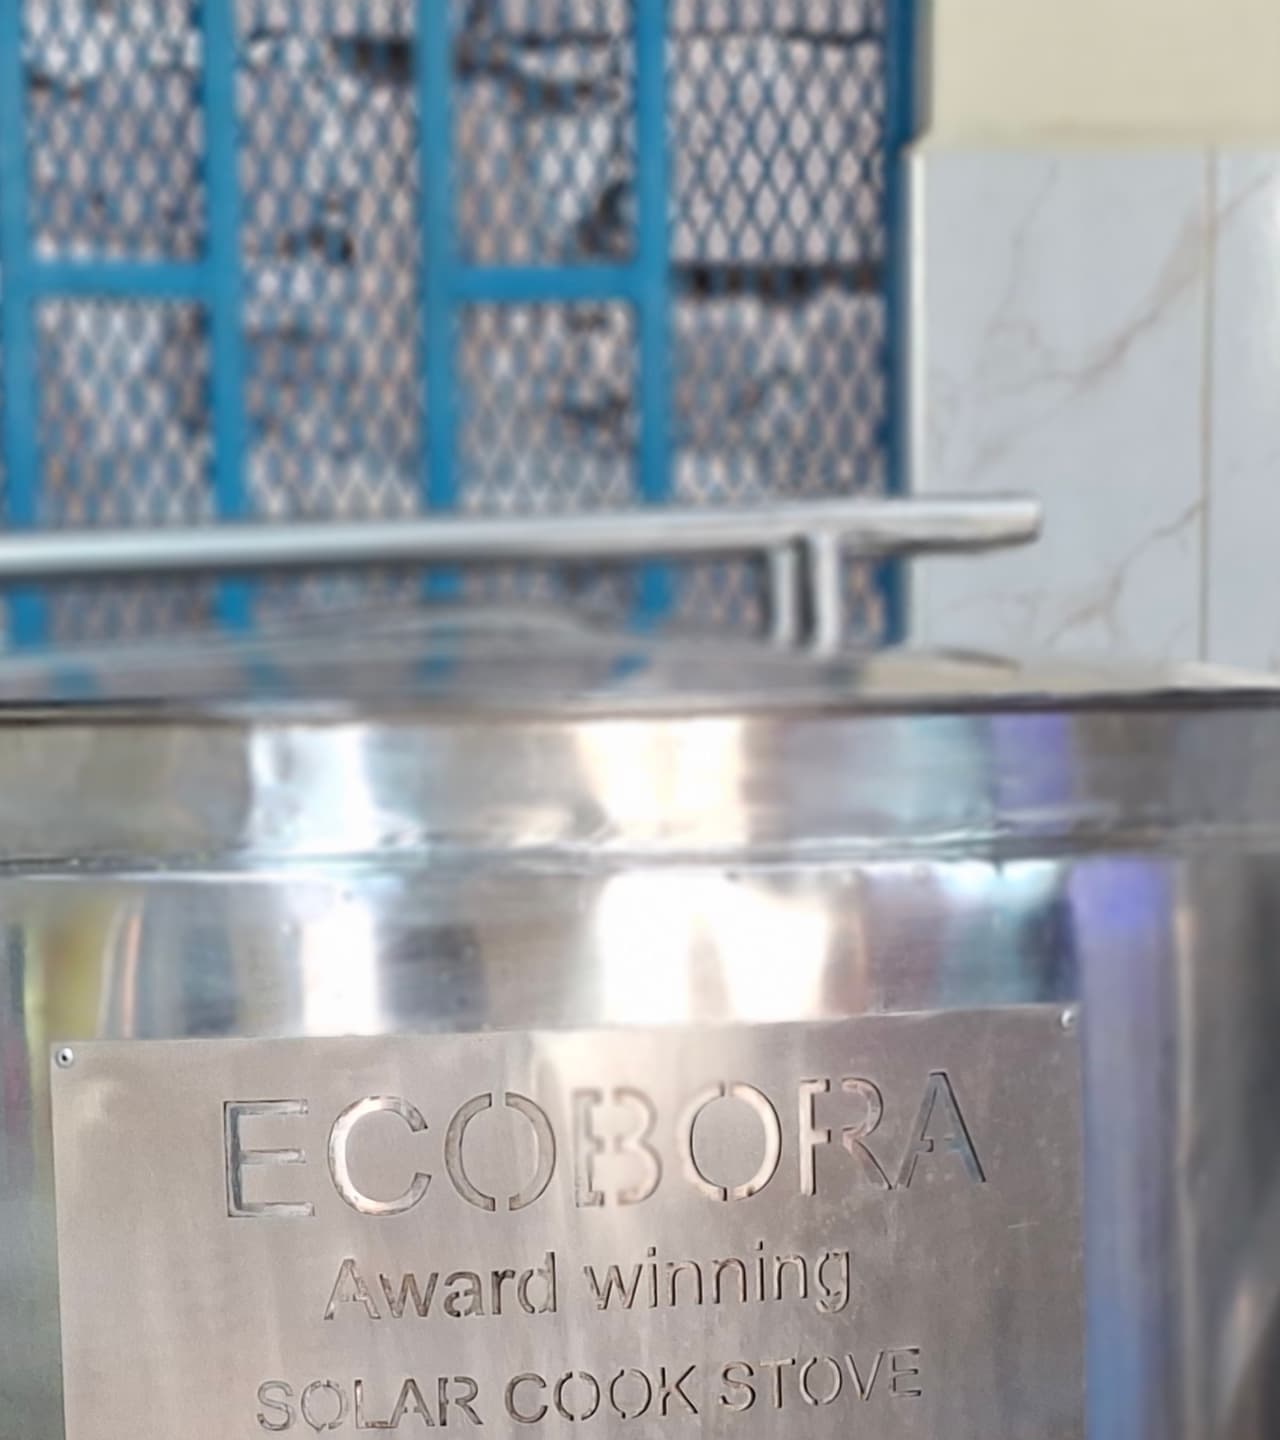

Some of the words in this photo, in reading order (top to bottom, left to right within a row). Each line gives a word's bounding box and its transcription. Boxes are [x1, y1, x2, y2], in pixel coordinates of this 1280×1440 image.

[222, 1071, 987, 1218] ECOBORA
[324, 1251, 557, 1321] Award
[583, 1241, 851, 1311] winning
[256, 1376, 483, 1432] SOLAR
[503, 1366, 699, 1425] COOK
[719, 1347, 922, 1413] STOVE
